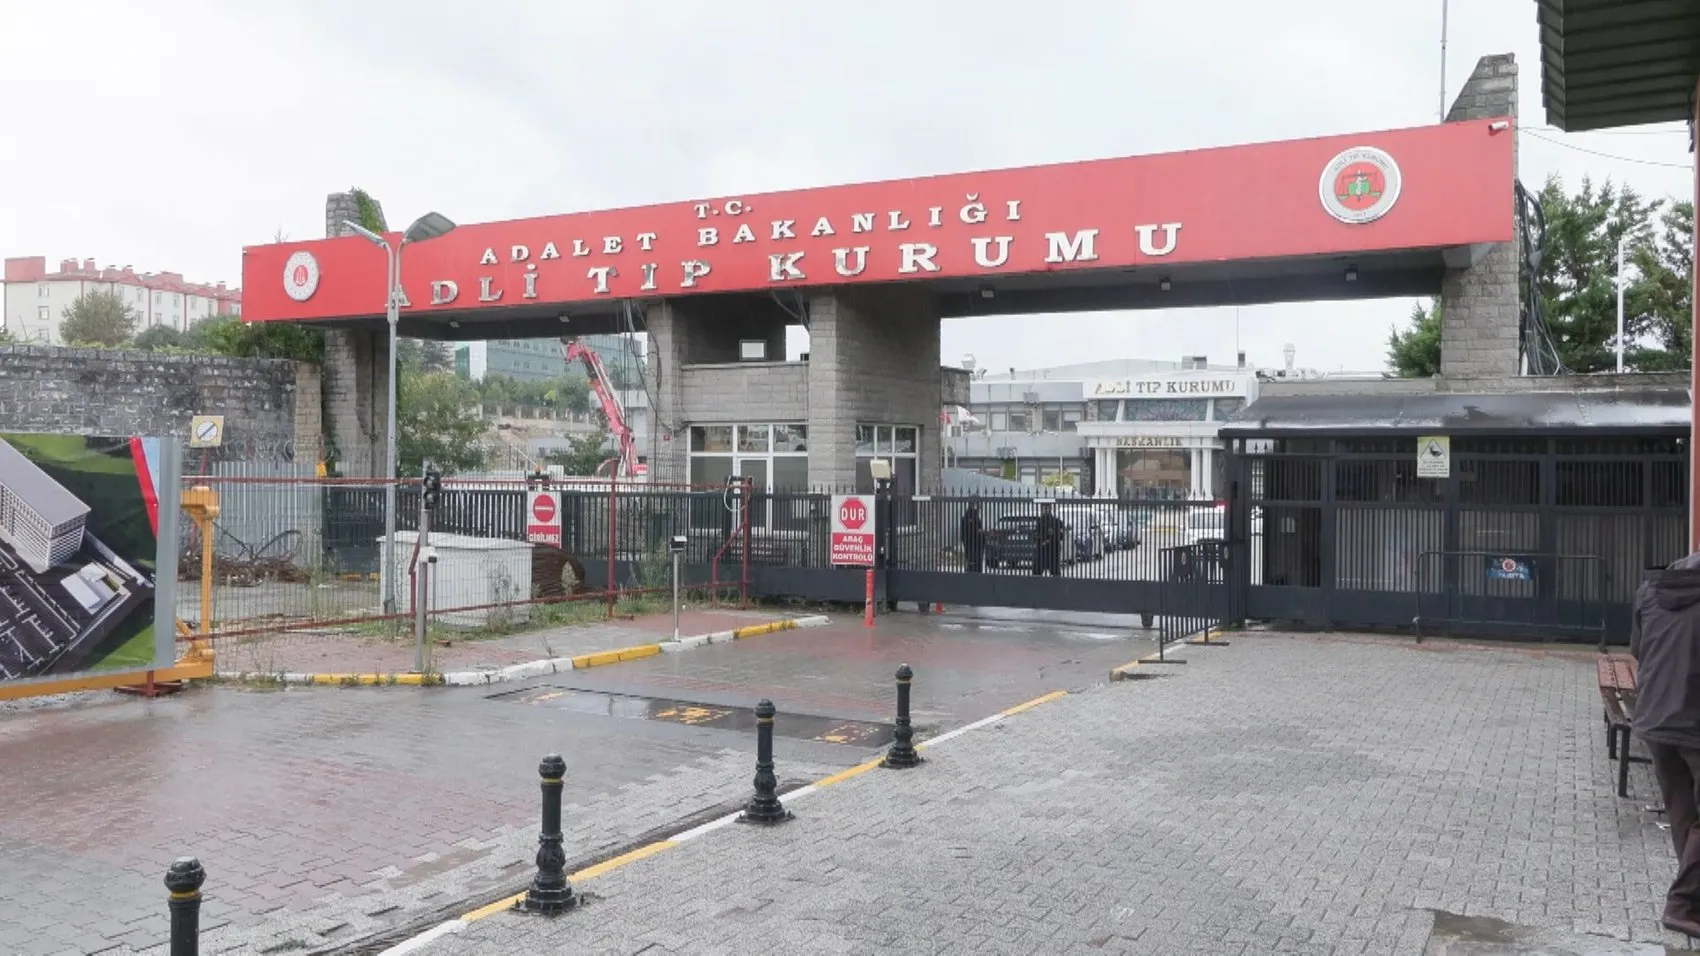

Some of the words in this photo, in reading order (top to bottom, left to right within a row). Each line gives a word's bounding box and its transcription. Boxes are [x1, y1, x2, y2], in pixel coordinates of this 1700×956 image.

[694, 200, 752, 219] T.C.
[480, 232, 657, 265] ADALET
[697, 192, 1021, 246] BAKANLIĞI
[384, 264, 538, 307] ADLİ
[587, 259, 711, 293] TIP
[768, 222, 1182, 282] KURUMU
[1136, 381, 1161, 393] TIP
[1166, 380, 1236, 393] KURUMU
[841, 507, 865, 521] DUR
[528, 532, 559, 543] GİRİLMEZ
